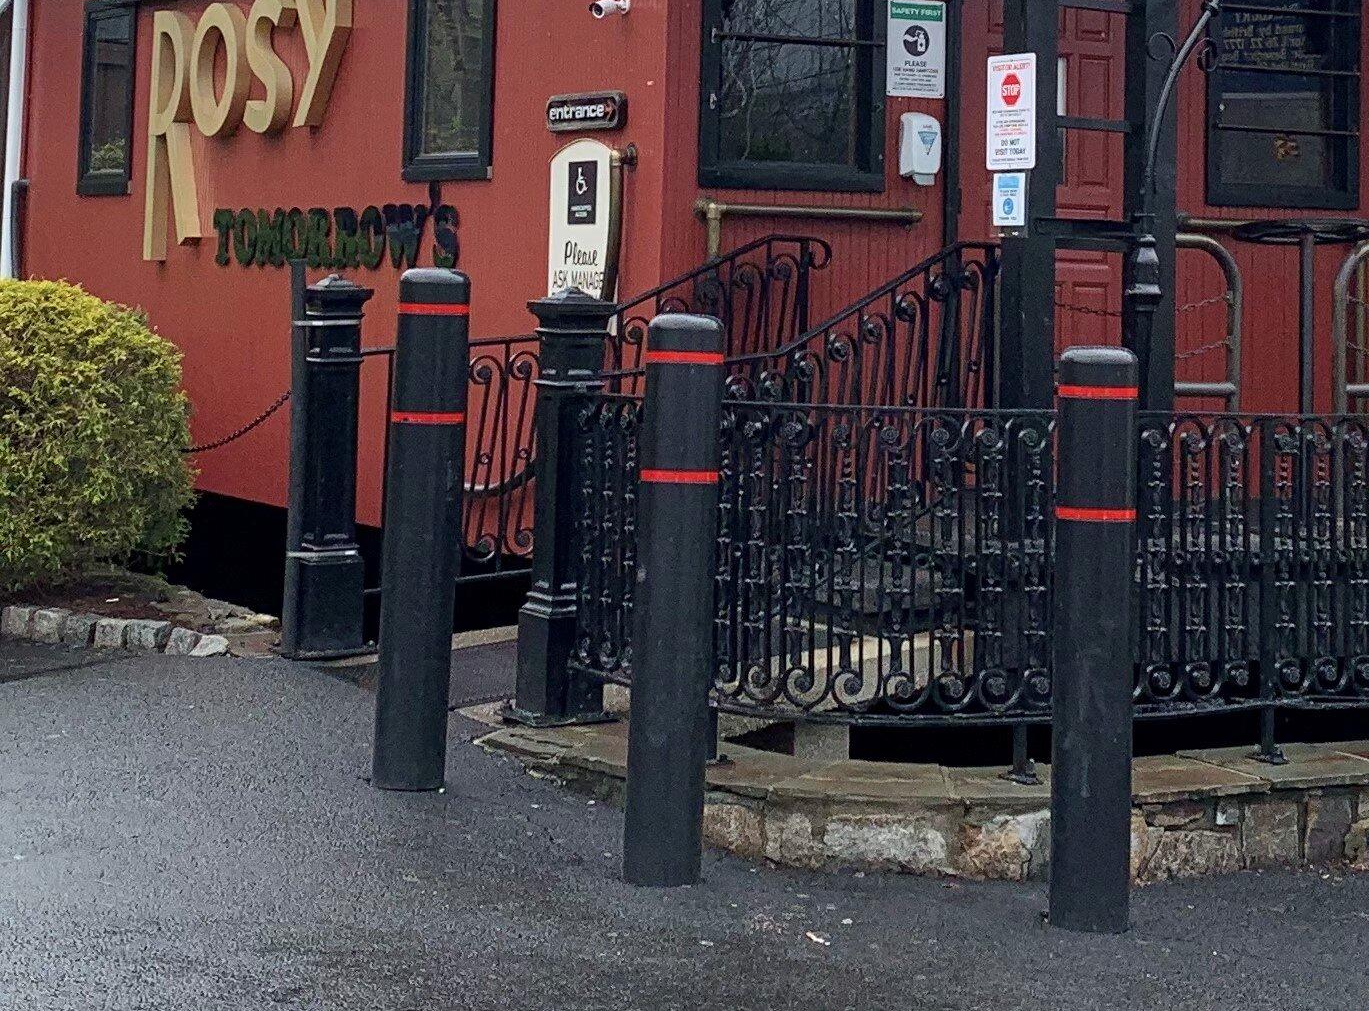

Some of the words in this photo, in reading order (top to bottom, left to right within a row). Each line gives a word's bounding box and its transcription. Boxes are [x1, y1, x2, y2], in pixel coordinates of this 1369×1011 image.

[892, 6, 919, 16] SAFETY
[921, 8, 941, 17] FIRST
[904, 60, 927, 68] PLEASE
[1002, 84, 1020, 97] STOP
[550, 103, 604, 120] entrance
[1010, 138, 1020, 146] NOT
[213, 202, 460, 271] TOMORROW'S
[564, 240, 598, 266] Please
[552, 270, 568, 289] ASK
[571, 271, 604, 290] MANAGE
